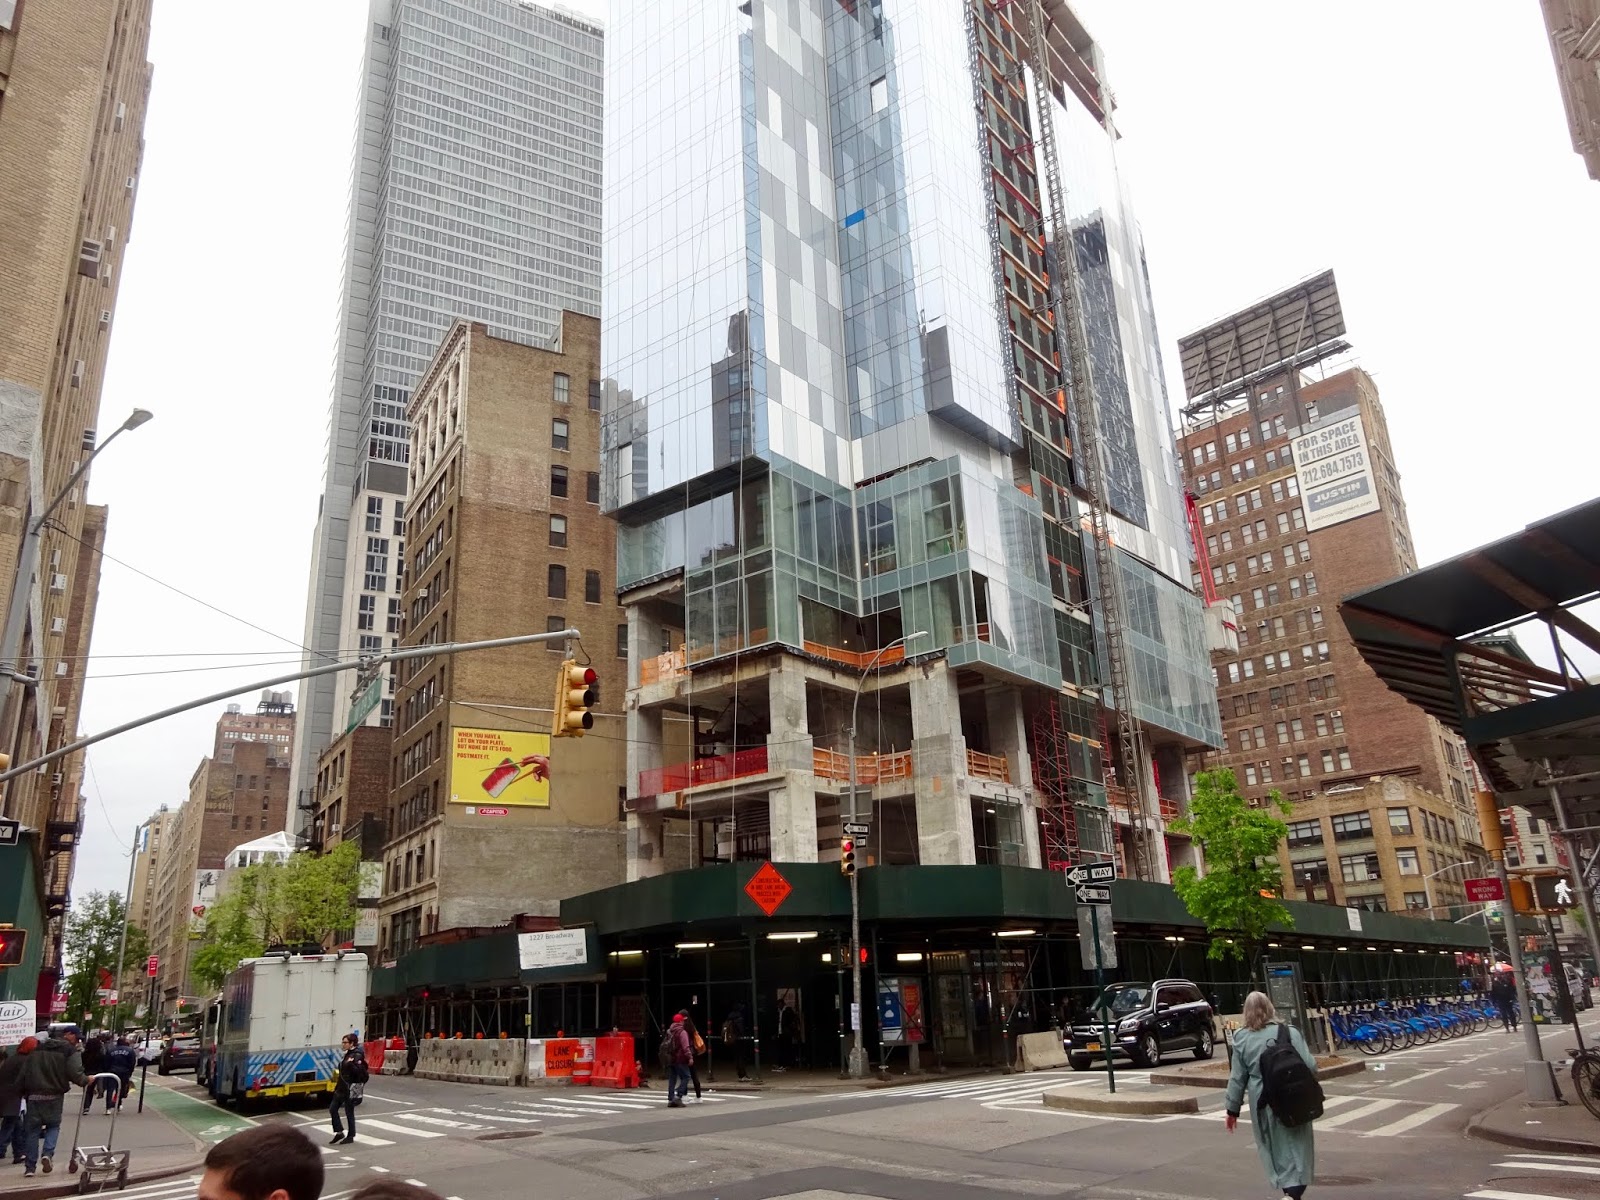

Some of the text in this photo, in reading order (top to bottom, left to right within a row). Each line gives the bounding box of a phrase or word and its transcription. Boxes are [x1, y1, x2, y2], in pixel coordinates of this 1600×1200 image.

[1296, 421, 1356, 451] FOR SPACE
[1298, 434, 1360, 464] IN THIS AREA
[1302, 451, 1364, 485] 212.684.7573
[1314, 482, 1361, 503] JUSTIN
[1072, 867, 1111, 880] ONE WAY
[1080, 889, 1108, 898] ONE WAY
[529, 932, 574, 941] 1227 Broadway
[553, 1046, 570, 1056] LANE
[547, 1059, 575, 1070] CLOSUR
